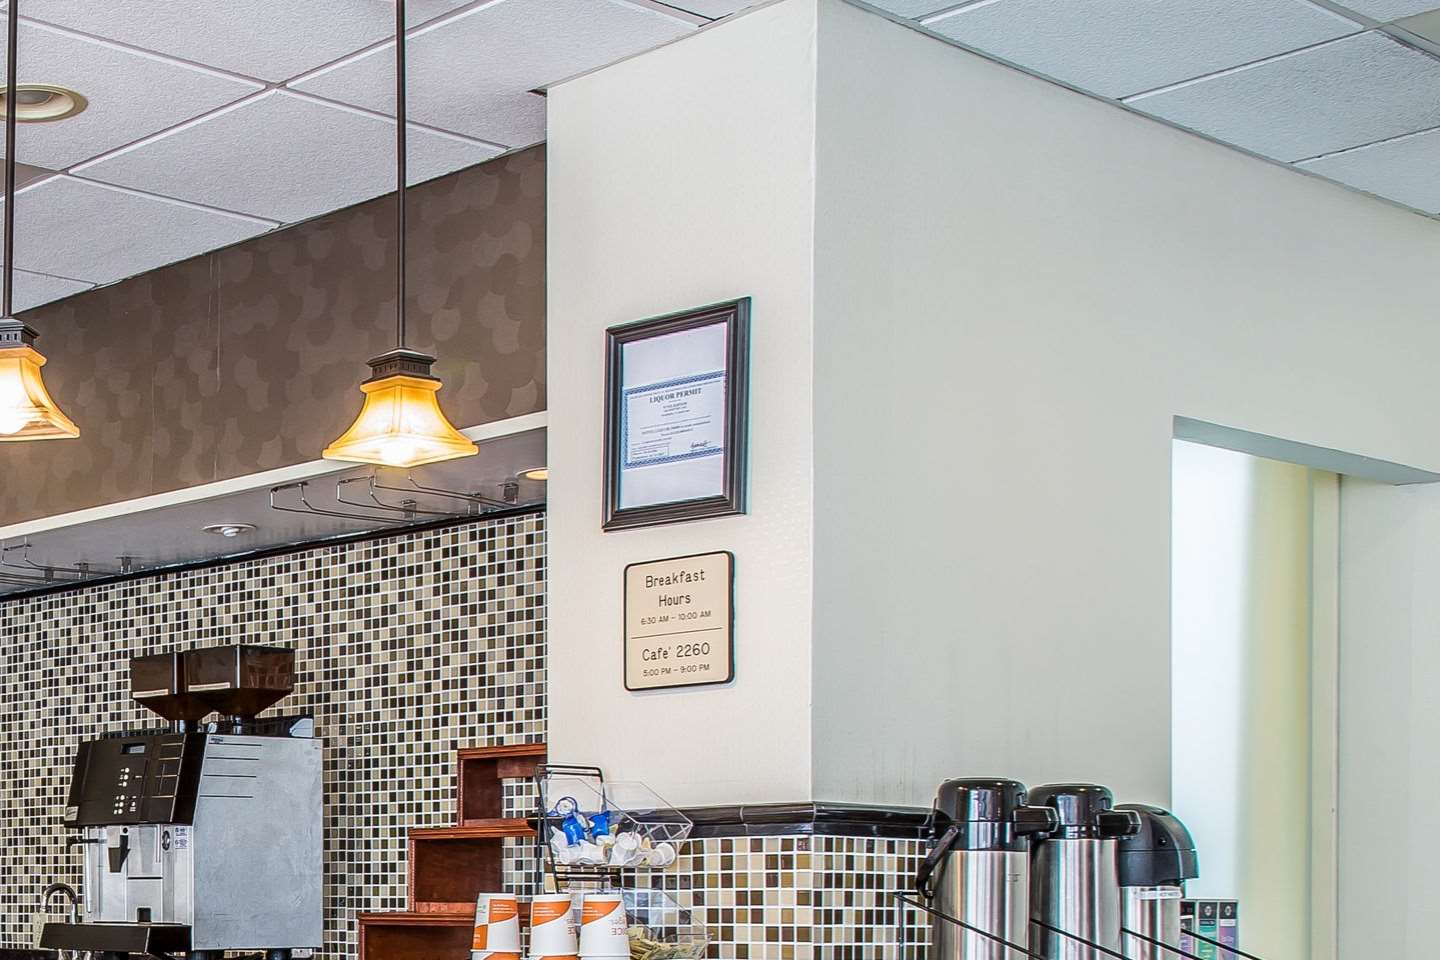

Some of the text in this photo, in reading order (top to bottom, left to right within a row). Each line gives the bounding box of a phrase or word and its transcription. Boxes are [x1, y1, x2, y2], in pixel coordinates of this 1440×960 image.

[649, 392, 675, 403] LIQUOR
[676, 387, 702, 399] PERMIT
[645, 569, 705, 588] Breakfast
[658, 594, 692, 607] Hours
[658, 615, 669, 623] AM
[678, 611, 698, 621] 10:00
[699, 610, 711, 618] AM
[676, 642, 711, 658] 2260
[643, 668, 659, 677] 5:00
[661, 667, 672, 675] PM
[680, 664, 697, 673] 9:00
[699, 663, 710, 671] PM
